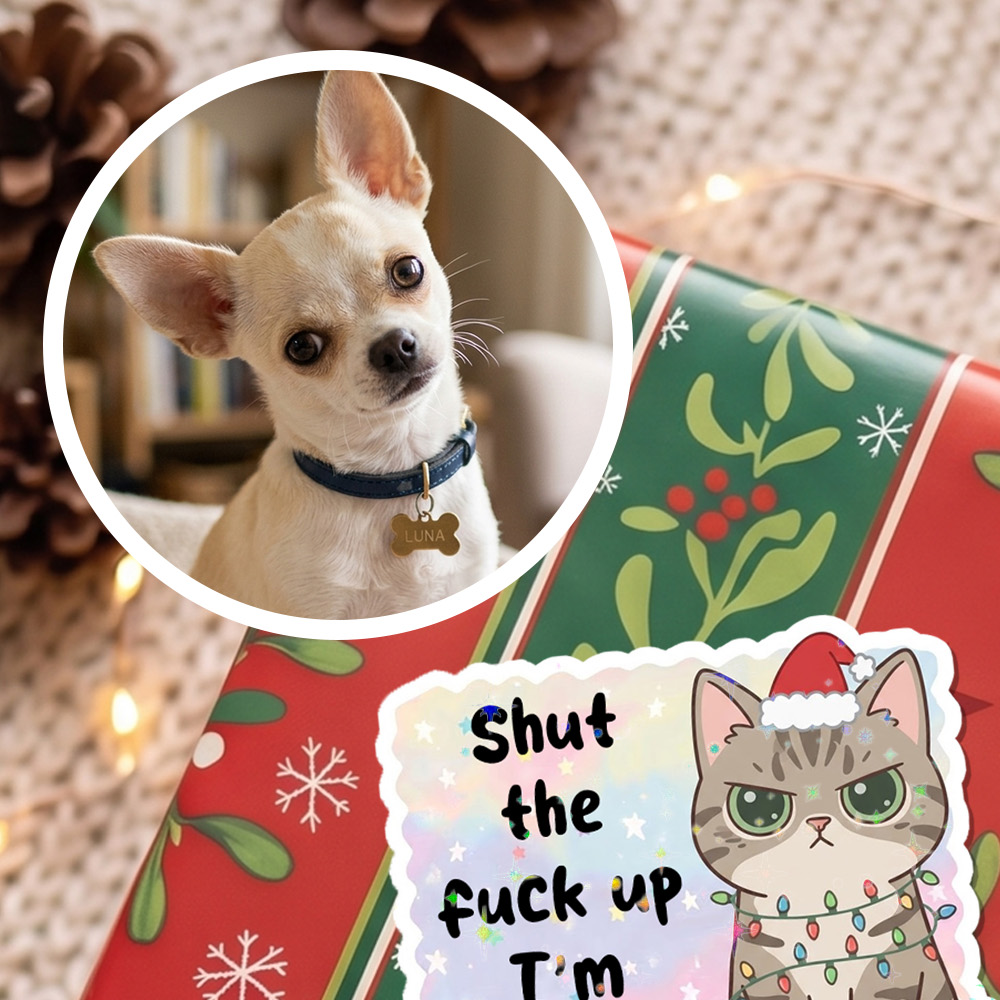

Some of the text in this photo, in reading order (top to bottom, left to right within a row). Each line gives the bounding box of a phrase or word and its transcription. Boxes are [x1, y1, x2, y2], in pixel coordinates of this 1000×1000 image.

[404, 529, 446, 543] LUNA
[471, 692, 616, 764] Shut
[501, 779, 603, 840] the
[438, 865, 682, 938] fuck up
